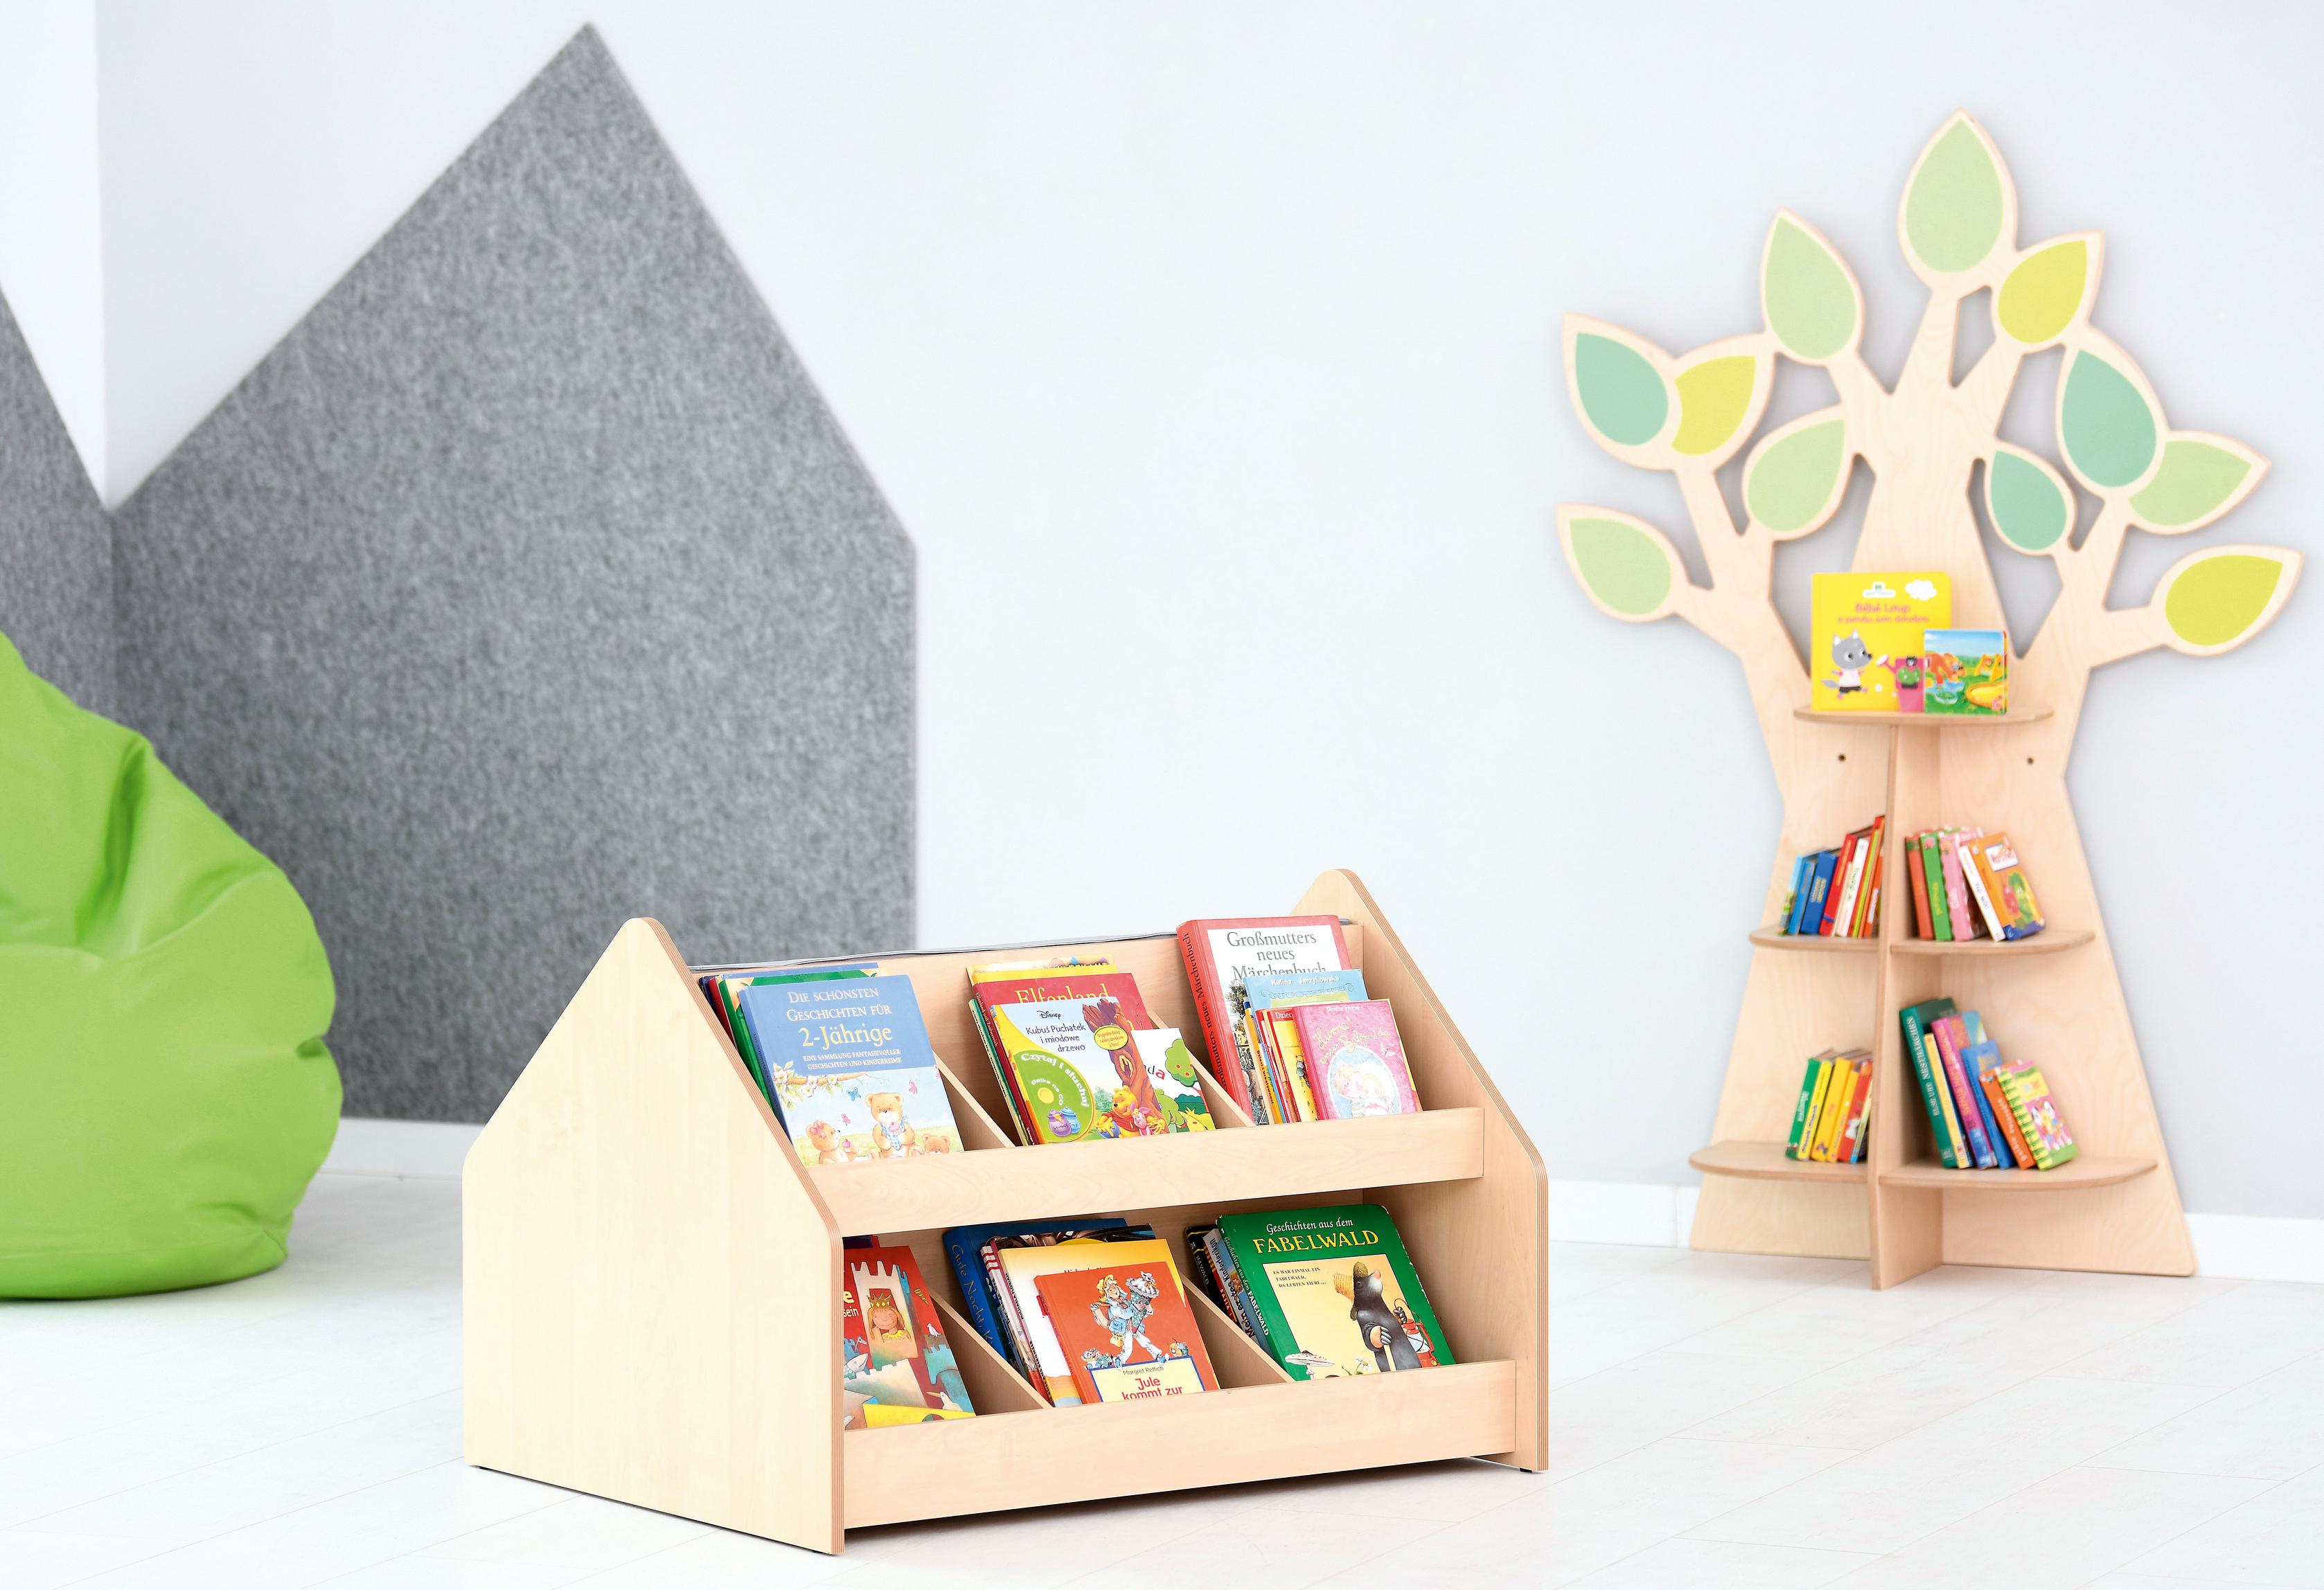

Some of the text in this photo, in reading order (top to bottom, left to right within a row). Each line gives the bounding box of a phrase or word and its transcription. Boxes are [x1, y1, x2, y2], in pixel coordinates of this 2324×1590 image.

[1227, 931, 1316, 946] Großmutters
[1257, 949, 1295, 961] neues
[1182, 932, 1205, 999] Märchenbuch
[975, 992, 986, 1014] Elfenland
[1014, 983, 1110, 1004] Elfenland
[787, 1004, 892, 1021] GESCHICHTEN FÜR
[1036, 1010, 1061, 1019] Disney
[1202, 1001, 1212, 1029] neues
[799, 1023, 893, 1050] 2-Jährige
[1026, 1022, 1086, 1035] Kubuś Puchatek
[1045, 1034, 1080, 1043] miodowe
[817, 1052, 851, 1061] SAMMLUNG
[852, 1048, 901, 1058] FANTASIEVOLLER
[1057, 1044, 1086, 1053] drzewo
[863, 1057, 902, 1066] KINDERREIME
[1021, 1053, 1057, 1066] Czytaj
[1266, 1217, 1354, 1235] Geschichten aus dem
[1252, 1230, 1379, 1253] FABELWALD
[1209, 1238, 1230, 1283] Kinderlexikon
[952, 1244, 967, 1276] Gute
[964, 1280, 985, 1328] Nacht,
[1004, 1273, 1015, 1294] FLORIAN
[1225, 1237, 1240, 1270] Geschichten
[1248, 1291, 1269, 1336] FABELWALD
[1012, 1294, 1024, 1320] MICHAELA
[1221, 1288, 1230, 1310] BASIA
[1241, 1312, 1255, 1338] Mein
[1122, 1386, 1182, 1400] kommt zur
[1135, 1377, 1161, 1391] Jule
